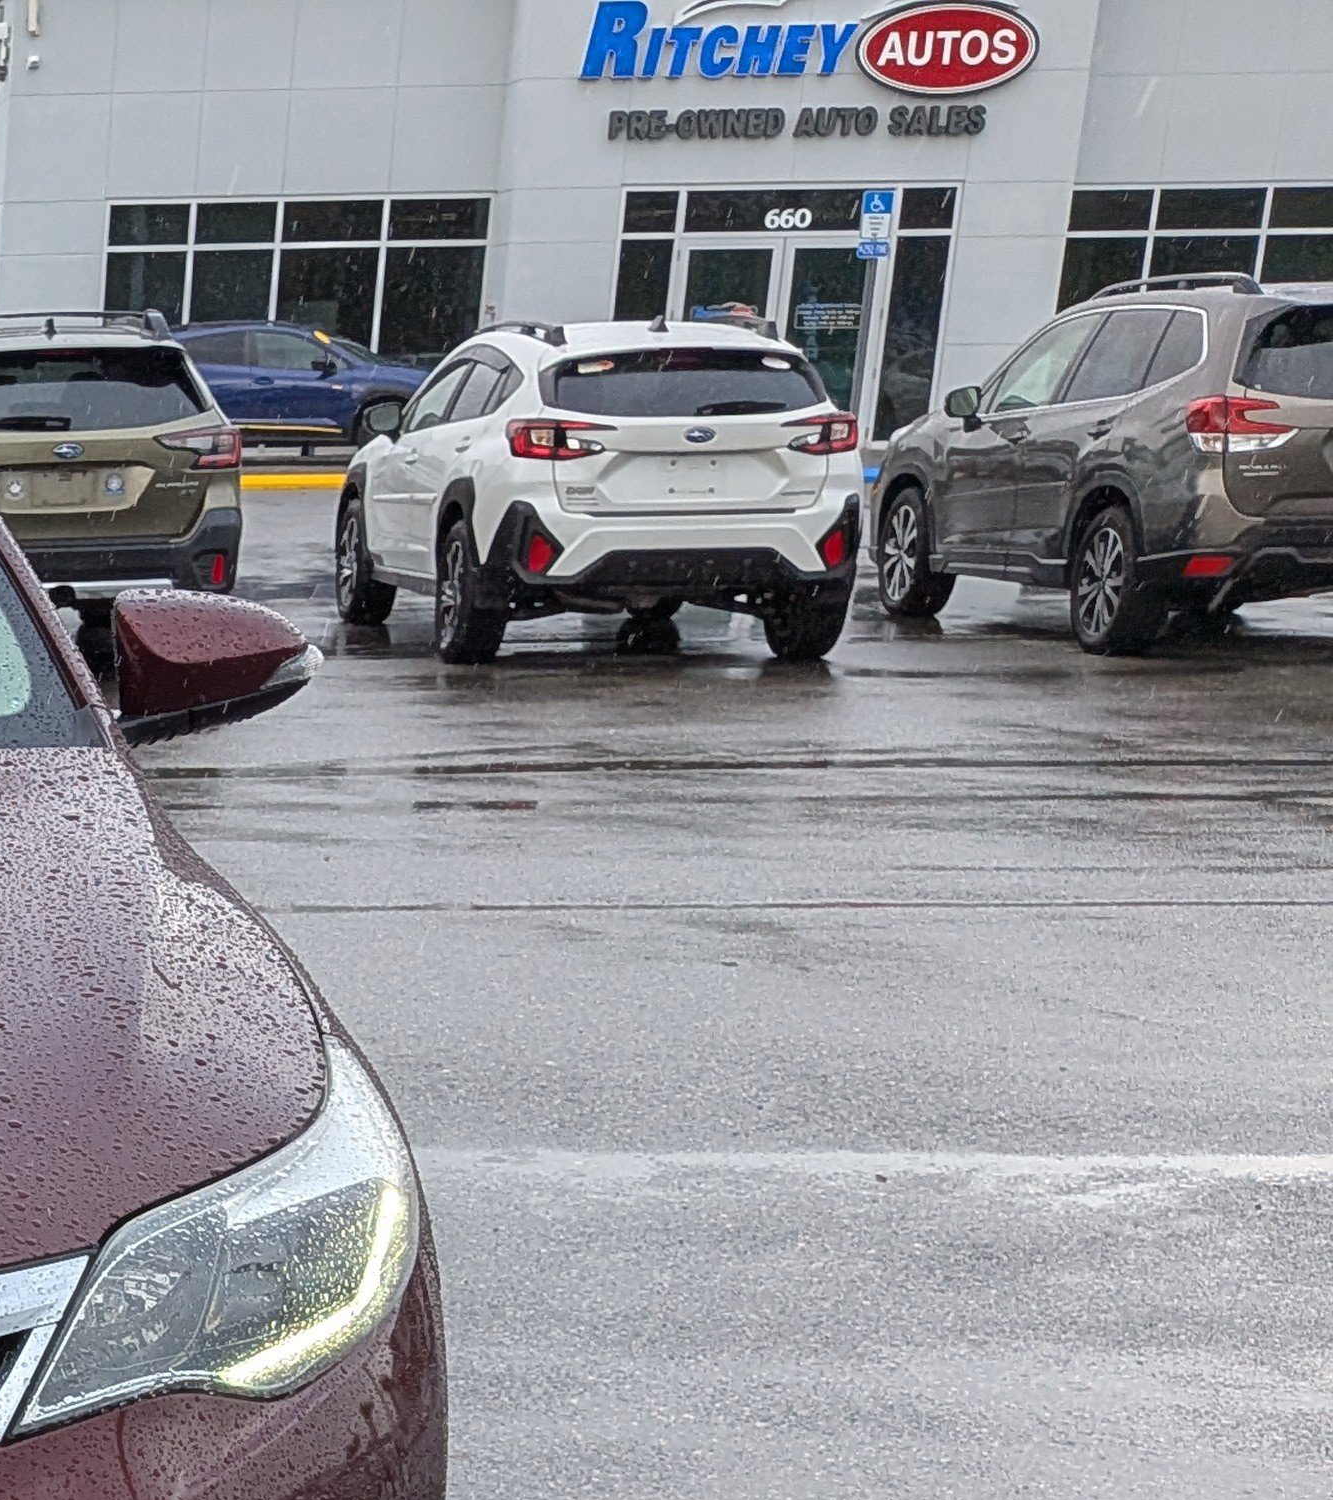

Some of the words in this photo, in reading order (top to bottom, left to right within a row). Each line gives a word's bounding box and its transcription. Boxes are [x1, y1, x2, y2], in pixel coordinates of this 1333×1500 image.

[579, 0, 859, 80] RITCHEY
[876, 29, 1018, 68] AUTOS
[609, 107, 786, 140] PRE-OWNED
[793, 106, 878, 138] AUTO
[888, 105, 987, 136] SALES
[764, 208, 812, 229] 660
